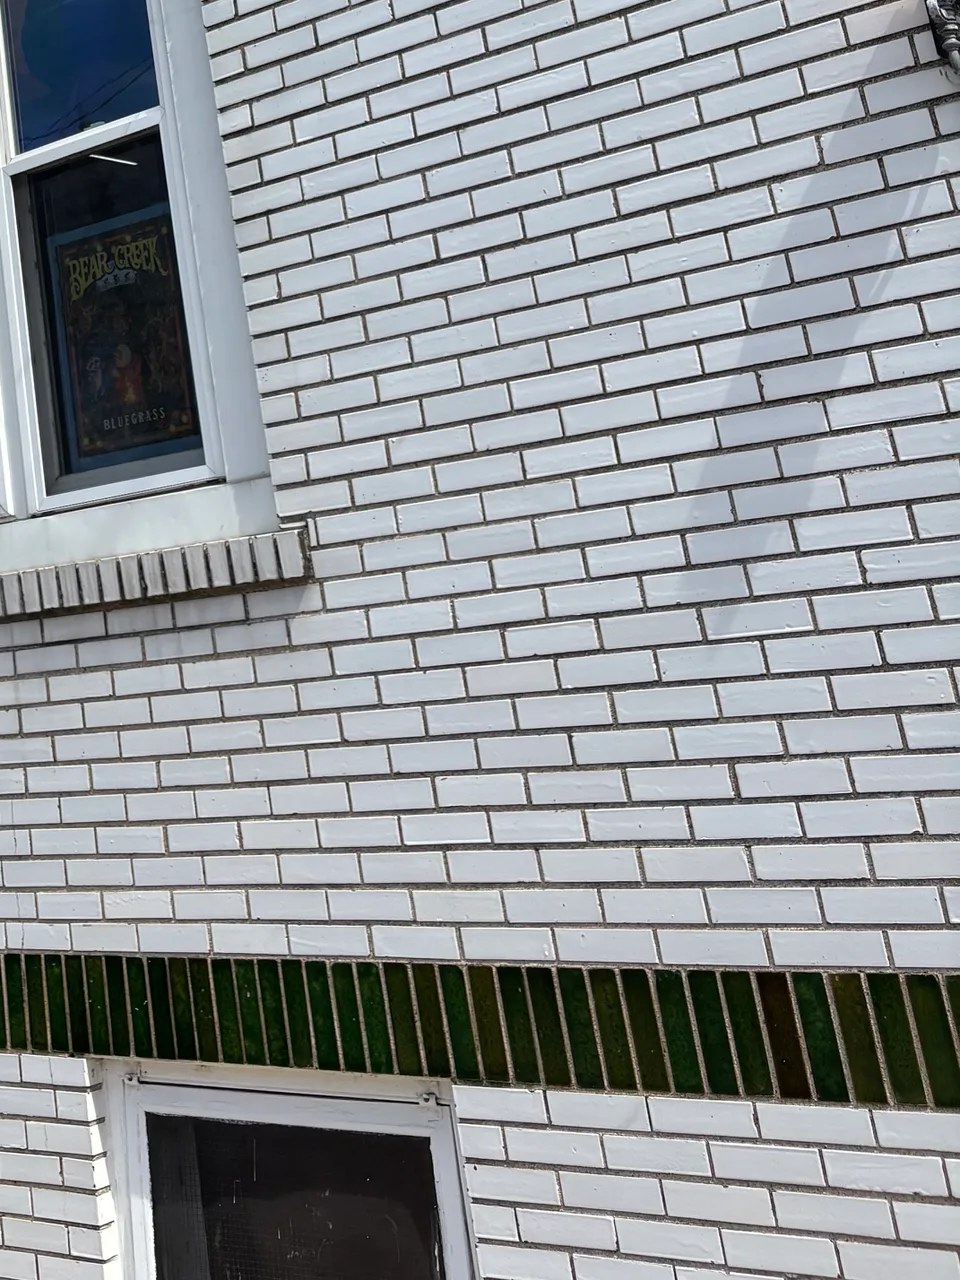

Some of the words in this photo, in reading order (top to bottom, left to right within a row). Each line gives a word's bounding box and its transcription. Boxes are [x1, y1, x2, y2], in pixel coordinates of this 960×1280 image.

[67, 251, 114, 302] BEAR
[113, 236, 169, 275] CREEK
[103, 407, 166, 430] BLUEGRASS
